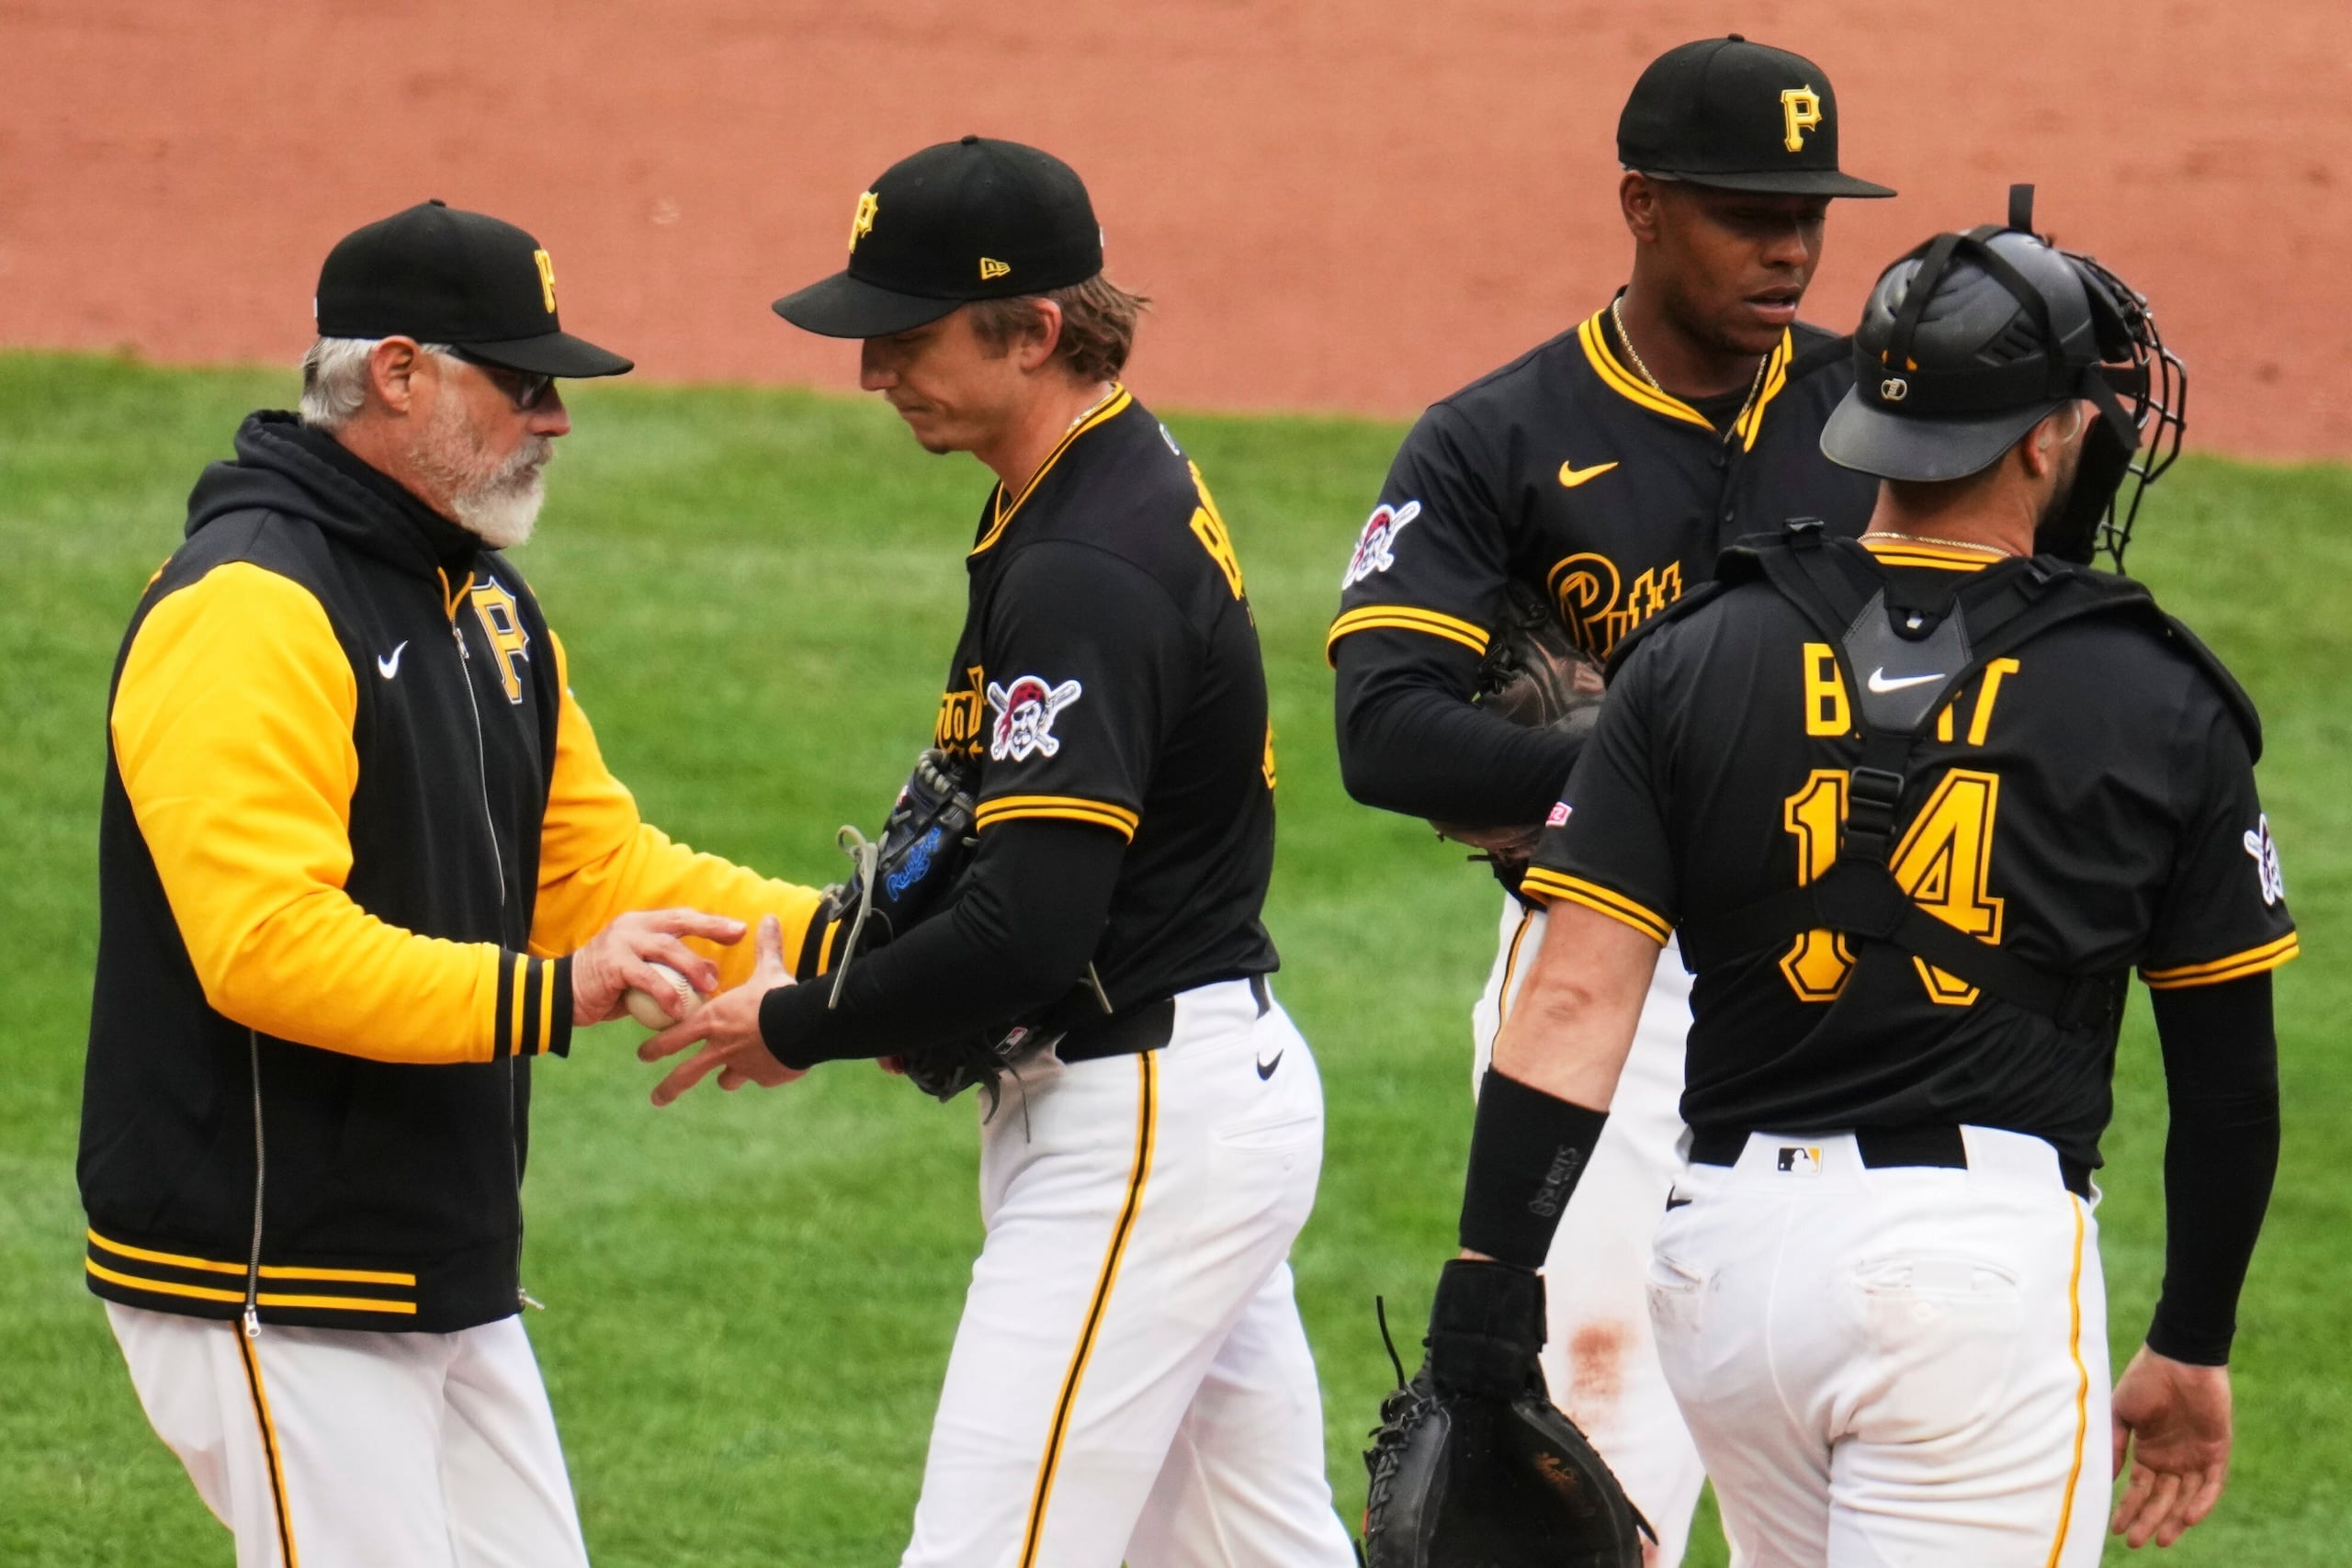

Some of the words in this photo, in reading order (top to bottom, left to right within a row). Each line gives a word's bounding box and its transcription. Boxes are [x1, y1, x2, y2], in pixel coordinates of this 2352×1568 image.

[1781, 84, 1823, 152] P
[849, 190, 879, 254] P
[470, 575, 530, 705] P
[1804, 642, 2020, 747] BT
[1779, 768, 2005, 1008] 14
